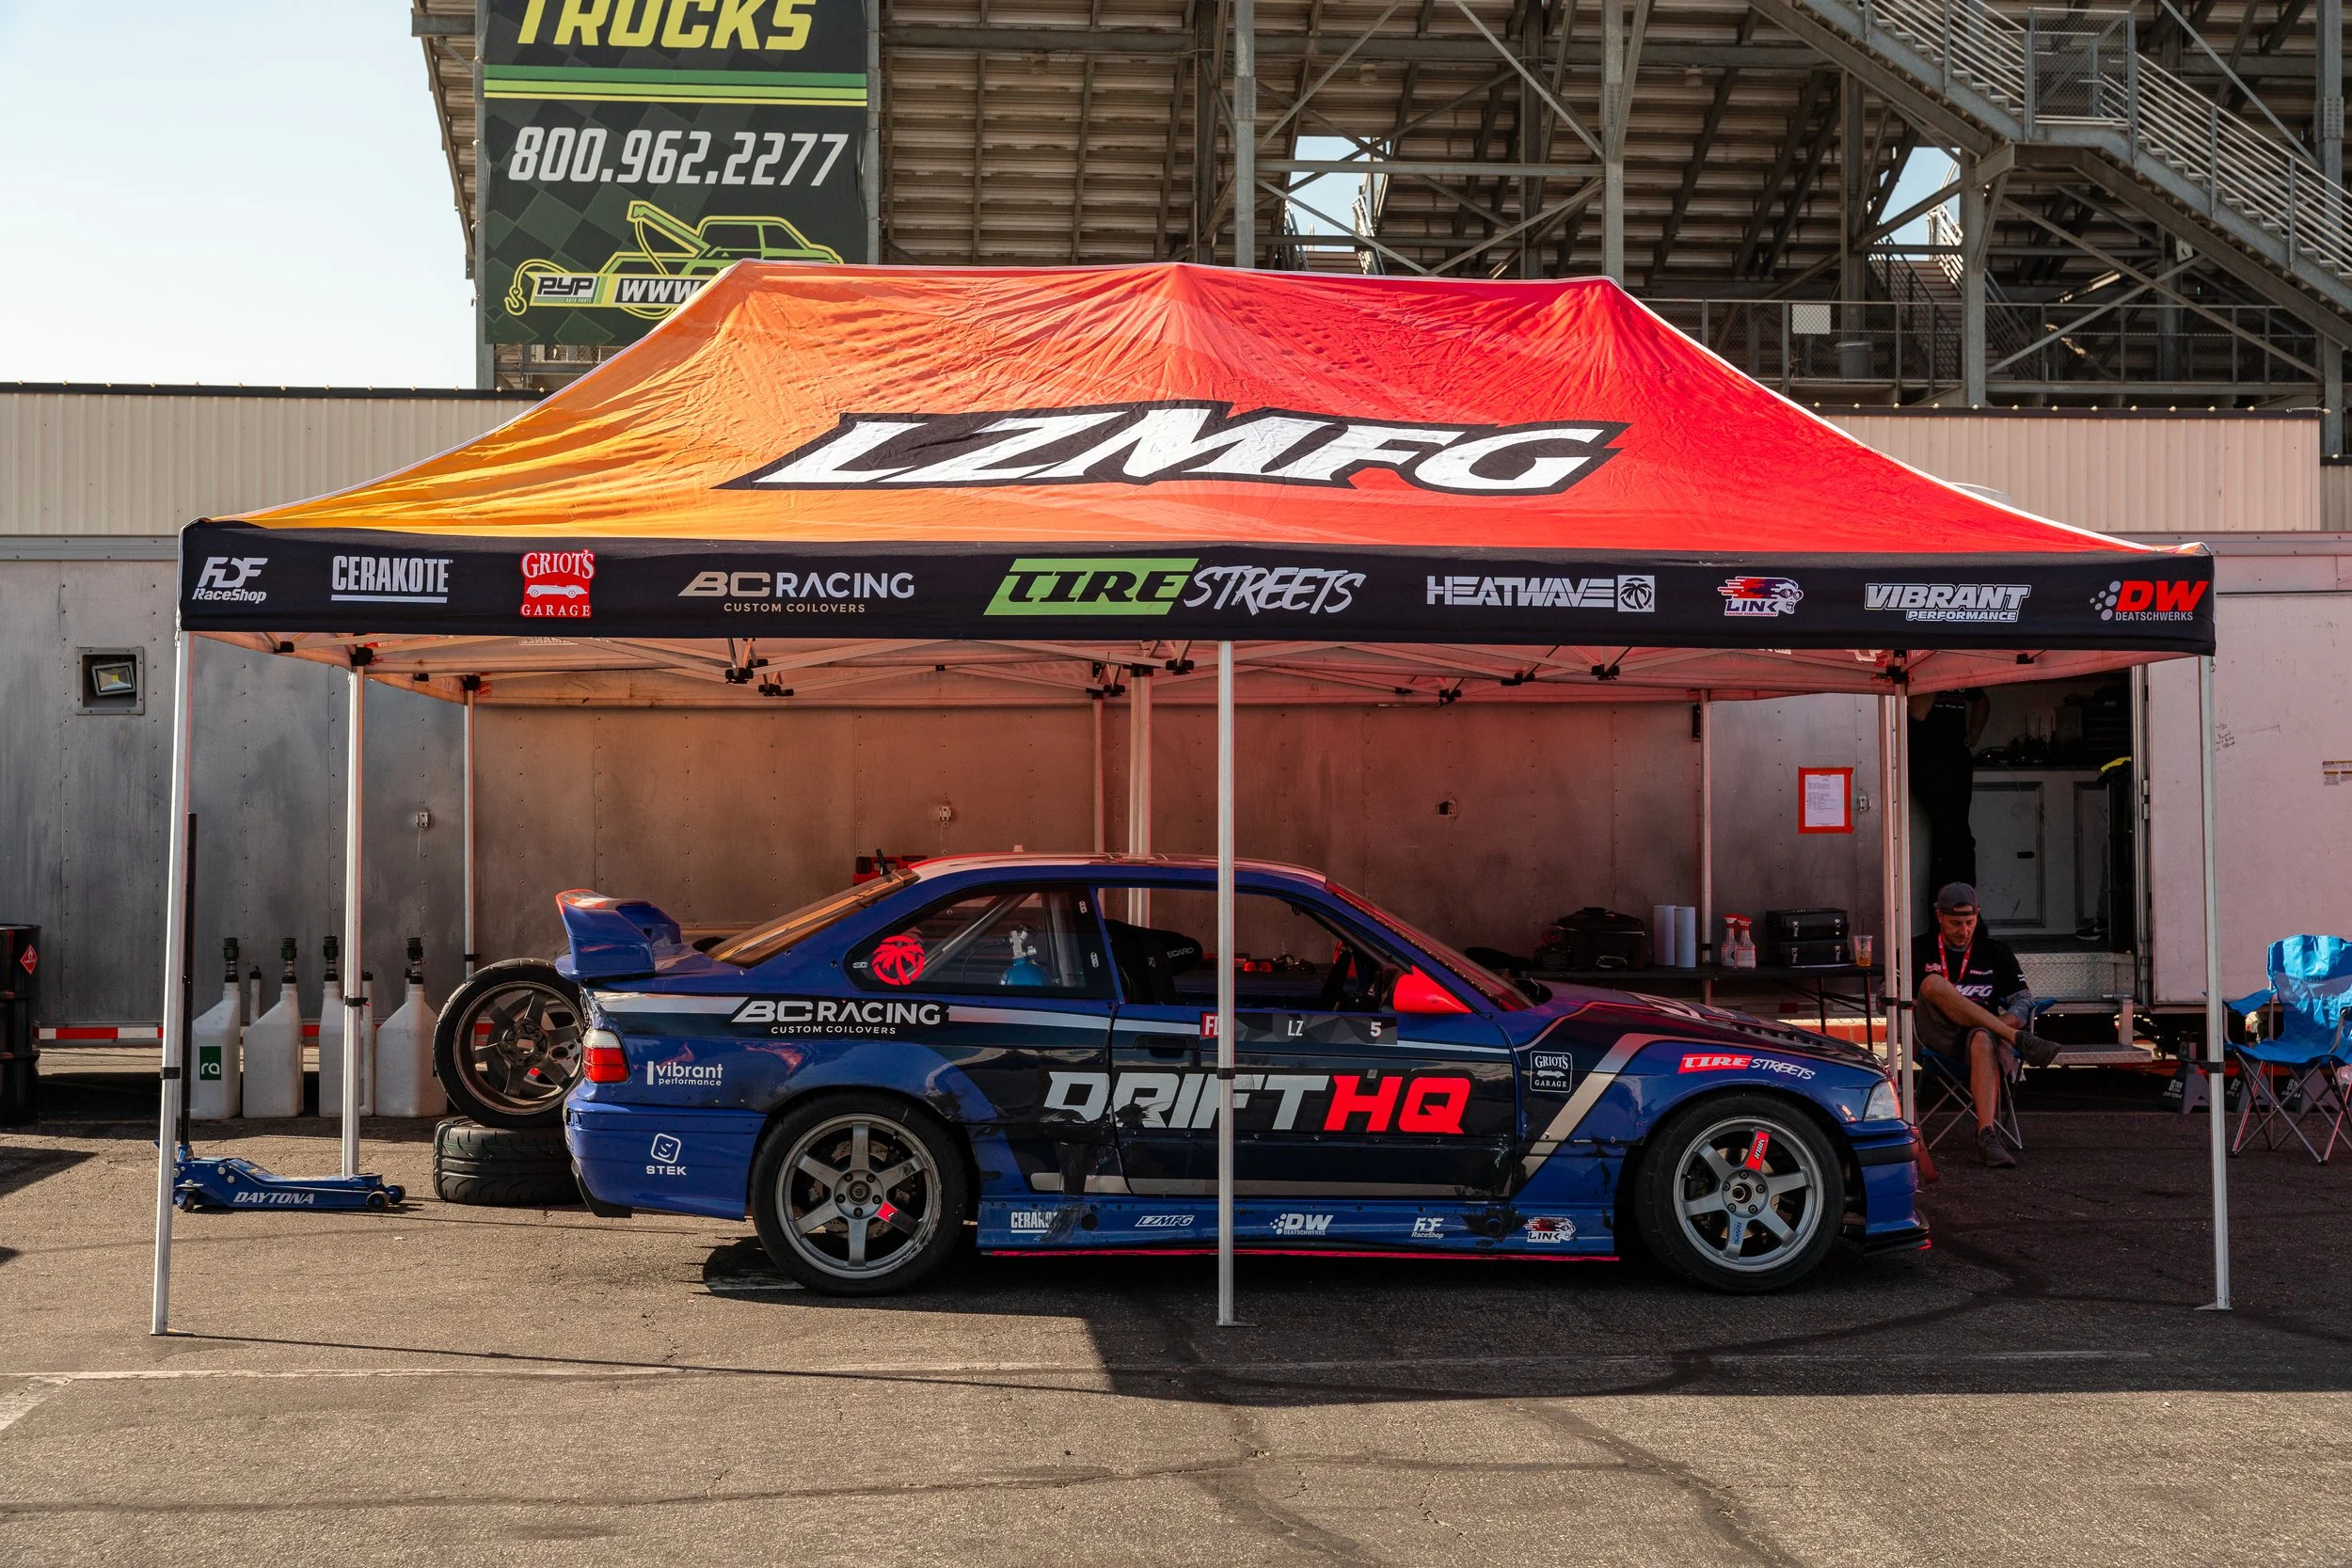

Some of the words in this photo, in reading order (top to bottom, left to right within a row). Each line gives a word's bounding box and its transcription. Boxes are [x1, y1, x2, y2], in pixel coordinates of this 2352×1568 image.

[517, 0, 816, 50] TRUCKS
[508, 127, 849, 186] 800.962.2277
[537, 277, 594, 295] PYP
[753, 407, 1603, 492] LZMFG
[522, 549, 594, 578] GRIOT'S
[332, 556, 450, 593] CERAKOTE
[677, 571, 771, 597] BC
[776, 572, 914, 598] RACING
[1008, 570, 1189, 603] TIRE
[1184, 564, 1367, 616] STREETS
[1427, 576, 1614, 608] HEATWAVE
[192, 588, 267, 604] RaceShop
[1866, 584, 2030, 610] VIBRANT
[2116, 580, 2208, 612] DW
[521, 604, 591, 616] GARAGE
[723, 603, 782, 613] CUSTOM
[787, 603, 866, 613] COILOVERS
[1725, 600, 1778, 612] LINK
[1906, 610, 2017, 622] PERFORMANCE
[2115, 610, 2193, 622] DEATSCHWERKS
[731, 1000, 812, 1022] BC
[818, 1002, 941, 1025] RACING
[771, 1025, 822, 1034] CUSTOM
[826, 1025, 896, 1035] COILOVERS
[1287, 1021, 1303, 1037] LZ
[1370, 1022, 1382, 1037] 5
[656, 1062, 723, 1078] vibrant
[1534, 1055, 1568, 1069] GRIOT'S
[1682, 1056, 1752, 1068] TIRE
[1751, 1058, 1816, 1080] STREETS
[659, 1078, 722, 1086] performance
[645, 1165, 687, 1176] STEK
[233, 1192, 315, 1205] DAYTONA
[1011, 1212, 1057, 1228] CERAK
[1135, 1215, 1195, 1227] LZMFG
[1283, 1213, 1334, 1229] DW
[1734, 1222, 1742, 1244] RAYS
